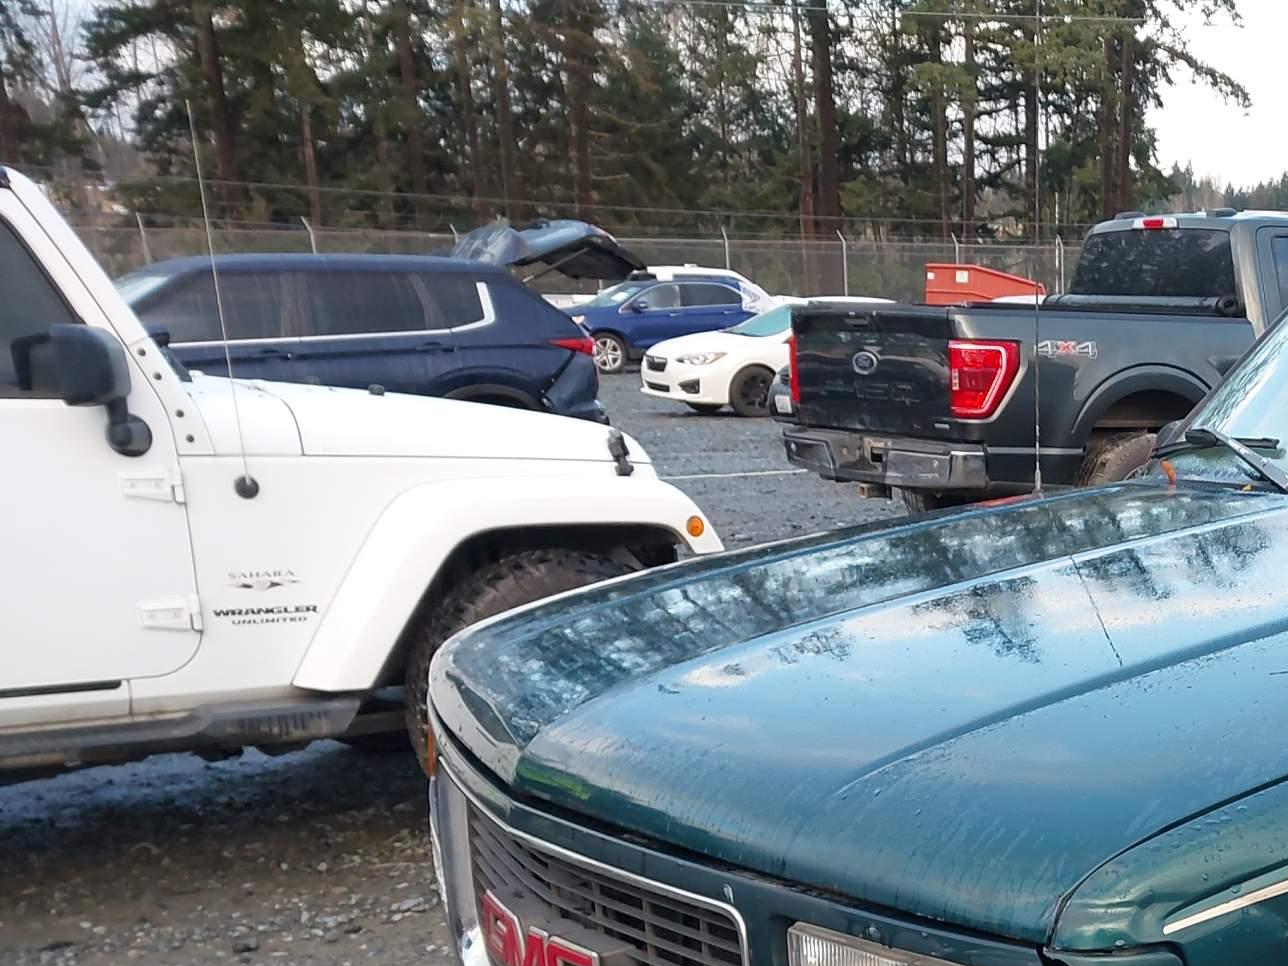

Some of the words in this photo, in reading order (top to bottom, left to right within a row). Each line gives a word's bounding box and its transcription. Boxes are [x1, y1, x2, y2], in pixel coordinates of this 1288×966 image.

[227, 569, 295, 579] SAHARA
[212, 604, 319, 618] WRANGLER
[231, 616, 307, 625] UNLIMITED
